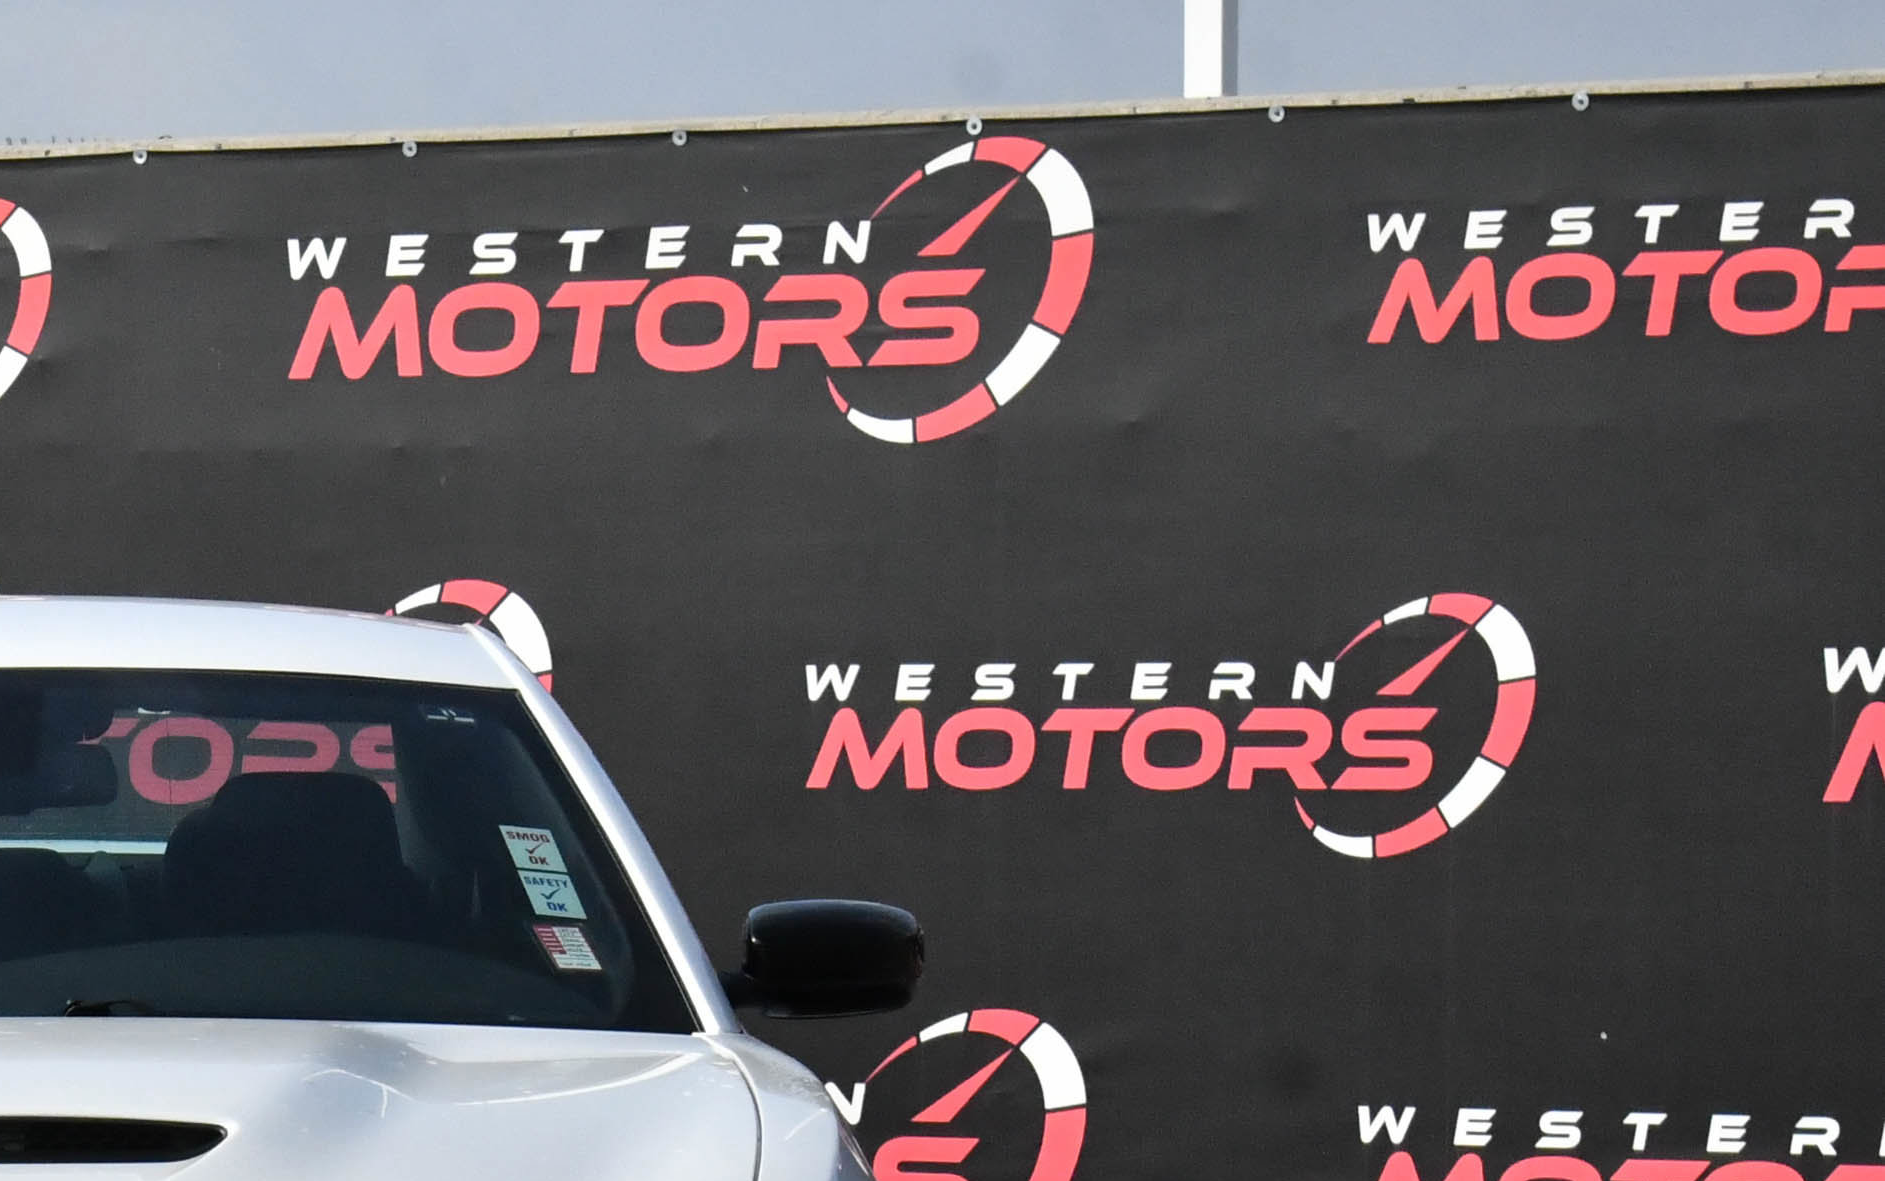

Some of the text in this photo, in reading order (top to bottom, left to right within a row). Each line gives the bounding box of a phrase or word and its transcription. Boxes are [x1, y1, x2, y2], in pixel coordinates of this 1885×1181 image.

[1368, 199, 1855, 253] WESTER
[287, 220, 871, 281] WESTERN
[288, 268, 986, 381] MOTORS
[805, 661, 1335, 701] WESTERN
[806, 706, 1438, 792] MOTORS
[506, 831, 550, 843] SMOG
[523, 876, 568, 888] SAFETY
[528, 856, 550, 865] OK
[546, 902, 568, 912] OK
[1358, 1105, 1885, 1157] WESTER
